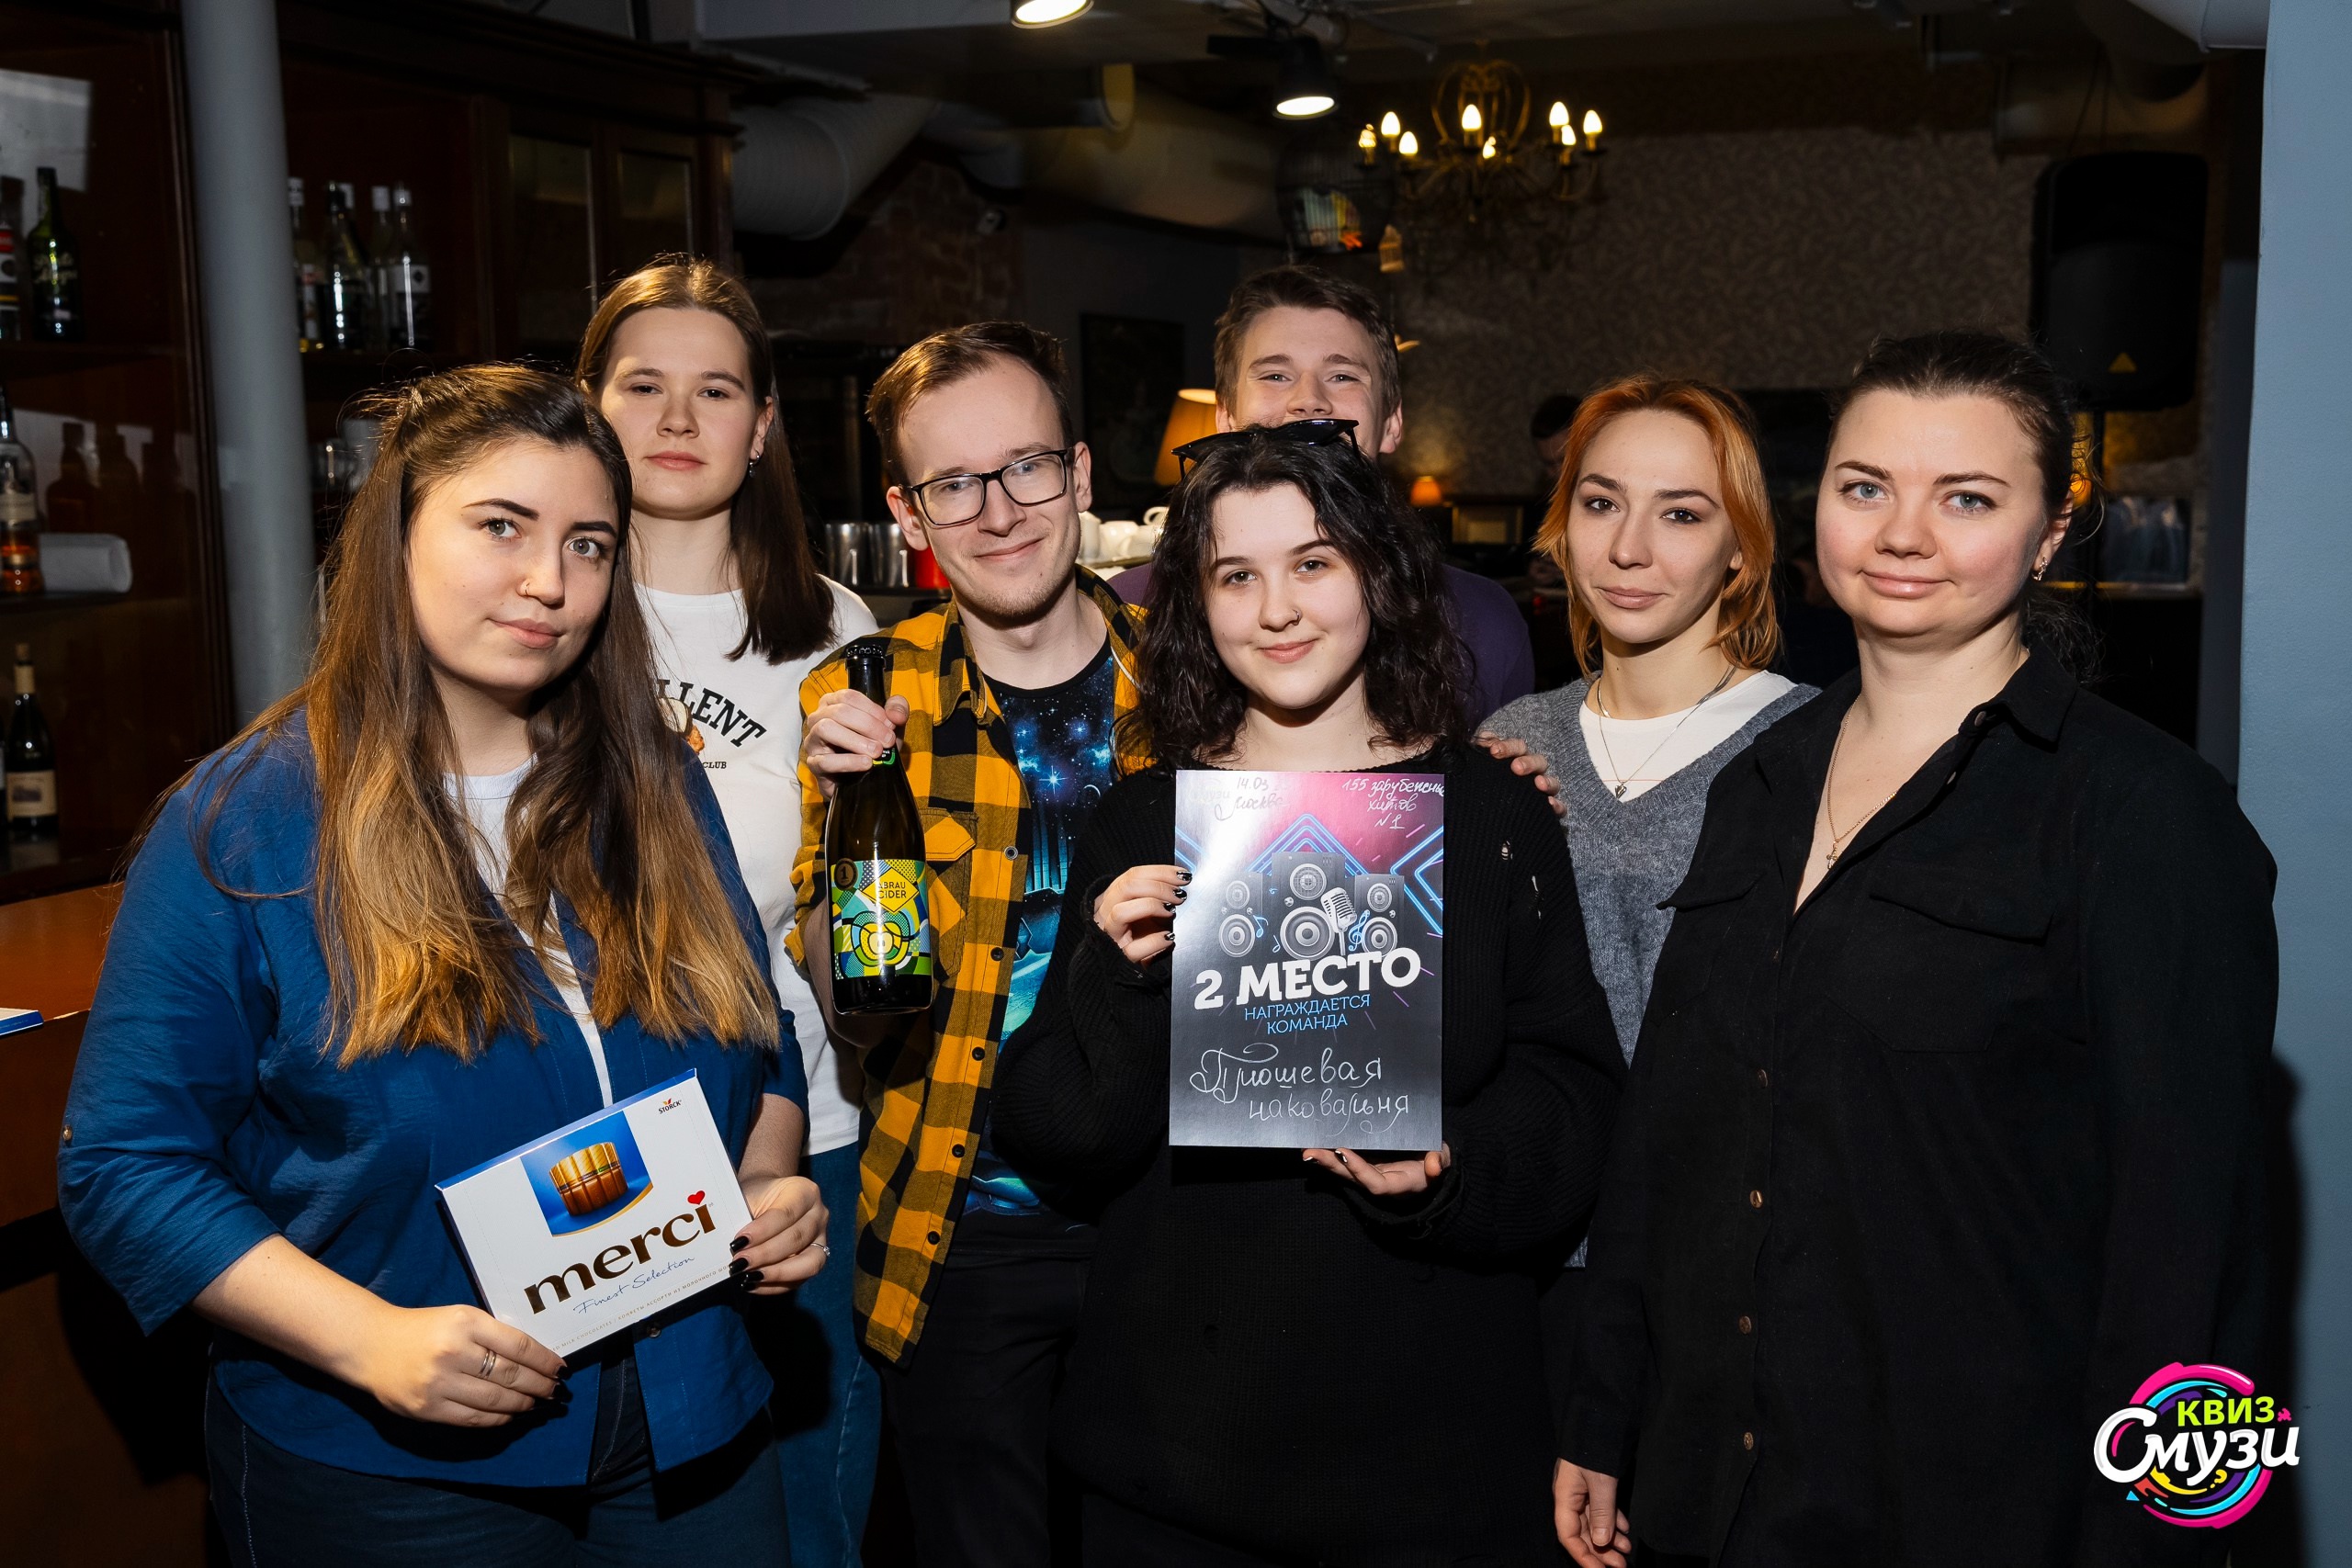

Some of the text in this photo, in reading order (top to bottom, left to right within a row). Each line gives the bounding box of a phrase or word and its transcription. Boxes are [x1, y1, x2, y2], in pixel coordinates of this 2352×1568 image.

[1237, 776, 1269, 791] 14.03
[1342, 779, 1369, 791] 155
[878, 890, 907, 898] CIDER
[1194, 947, 1421, 1010] 2 МЕСТО
[1244, 993, 1371, 1021] НАГРАЖДАЕТСЯ
[1266, 1013, 1348, 1035] КОМАНДА
[658, 1100, 682, 1114] STORCK
[524, 1190, 716, 1314] merci
[572, 1258, 695, 1314] Finest Selection
